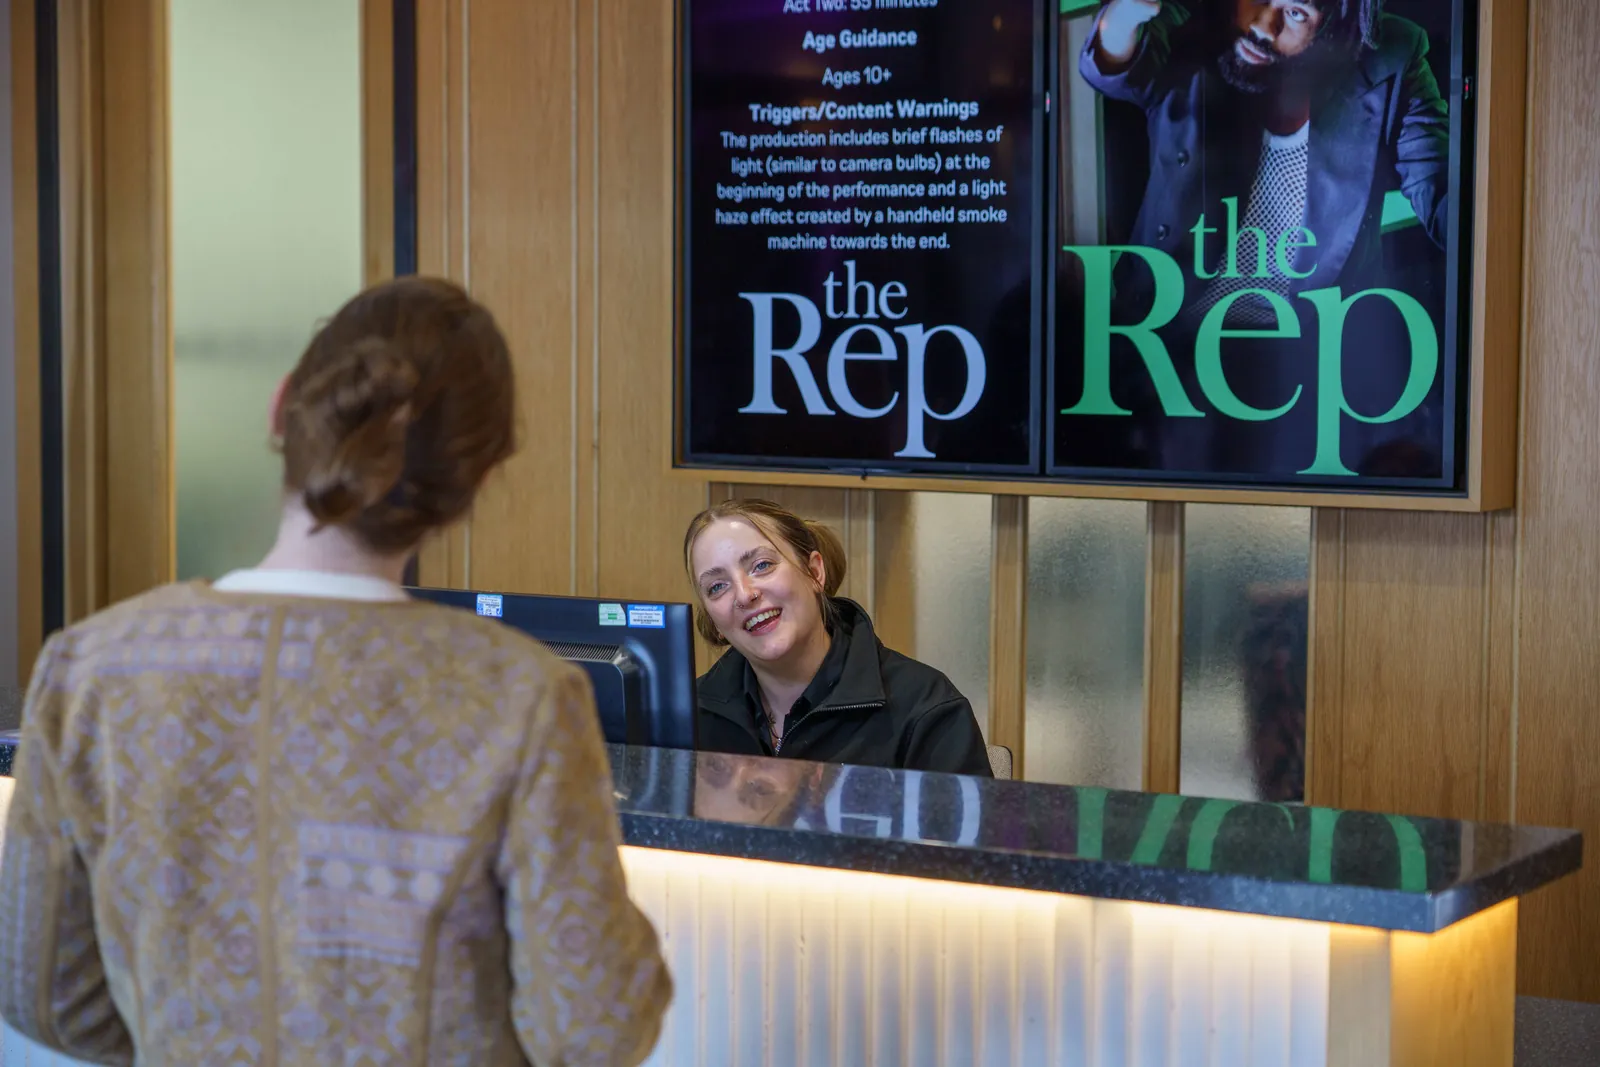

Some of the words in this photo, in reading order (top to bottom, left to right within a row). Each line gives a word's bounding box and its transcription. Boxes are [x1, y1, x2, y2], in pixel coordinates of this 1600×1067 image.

[783, 0, 811, 13] Act
[802, 30, 836, 54] Age
[839, 27, 918, 48] Guidance
[822, 67, 860, 90] Ages
[863, 65, 892, 84] 10+
[749, 100, 893, 127] Triggers/Content
[896, 97, 980, 122] Warnings
[720, 131, 747, 149] The
[750, 130, 826, 152] production
[829, 127, 889, 147] includes
[892, 126, 926, 145] brief
[929, 126, 983, 144] flashes
[986, 124, 1004, 144] of
[731, 157, 763, 178] light
[766, 155, 817, 178] (similar
[820, 157, 836, 174] to
[839, 157, 892, 173] camera
[895, 151, 942, 175] bulbs)
[945, 156, 962, 172] at
[964, 153, 991, 170] the
[716, 183, 784, 204] beginning
[787, 181, 803, 199] of
[805, 181, 830, 200] the
[833, 179, 925, 202] performance
[928, 179, 955, 197] and
[959, 183, 969, 197] a
[972, 178, 1007, 201] light
[715, 207, 748, 225] haze
[751, 206, 793, 224] effect
[796, 205, 851, 224] created
[854, 205, 872, 228] by
[875, 210, 884, 224] a
[886, 203, 955, 223] handheld
[958, 206, 1008, 222] smoke
[768, 231, 827, 250] machine
[830, 232, 888, 250] towards
[891, 231, 916, 249] the
[919, 231, 950, 249] end.
[1189, 196, 1318, 280] the
[823, 259, 909, 320] the
[1061, 245, 1439, 476] Rep
[738, 292, 987, 459] Rep
